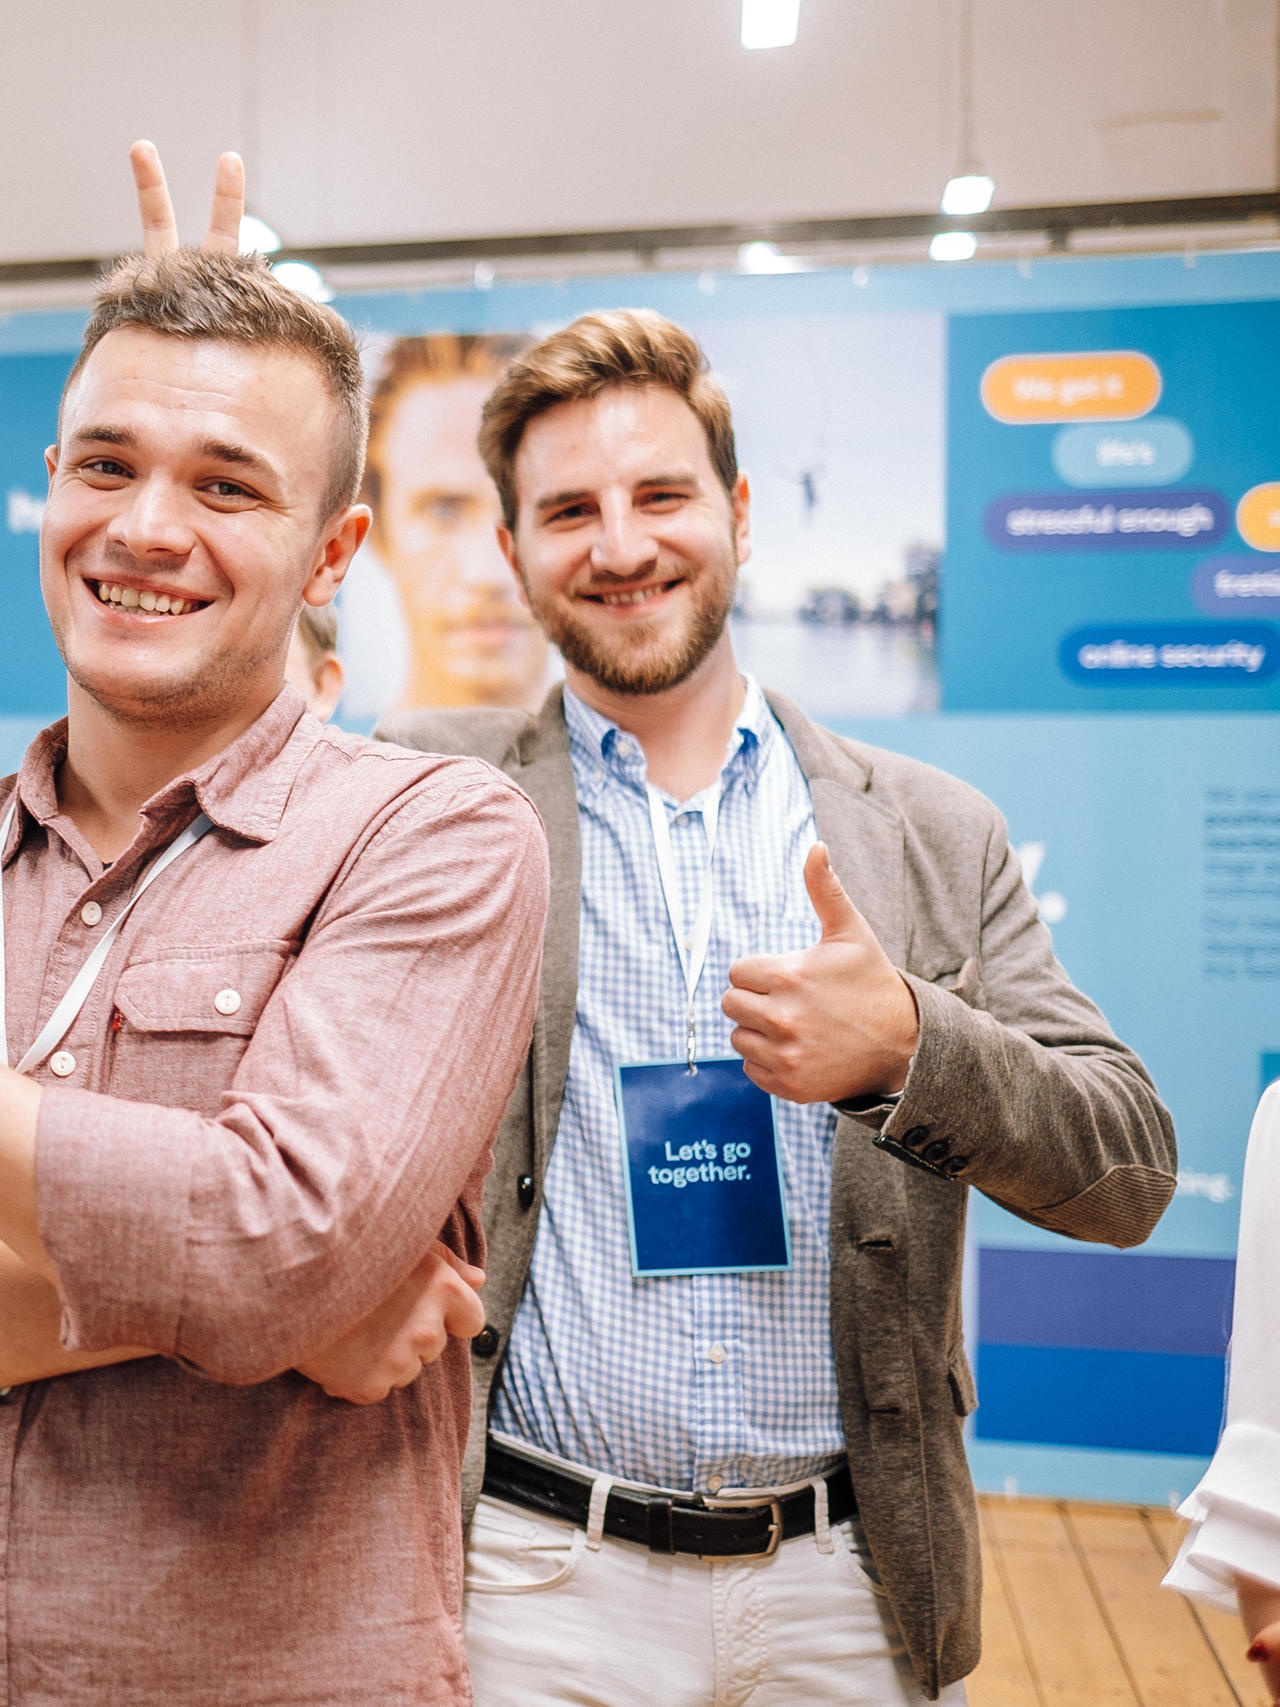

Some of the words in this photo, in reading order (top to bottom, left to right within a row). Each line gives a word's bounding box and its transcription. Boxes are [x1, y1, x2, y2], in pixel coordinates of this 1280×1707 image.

[1006, 504, 1115, 537] stressful
[1117, 503, 1215, 538] enough
[1078, 639, 1157, 670] online
[1158, 639, 1266, 673] security
[664, 1139, 718, 1162] Let's
[722, 1142, 751, 1164] go
[648, 1161, 751, 1189] together.
